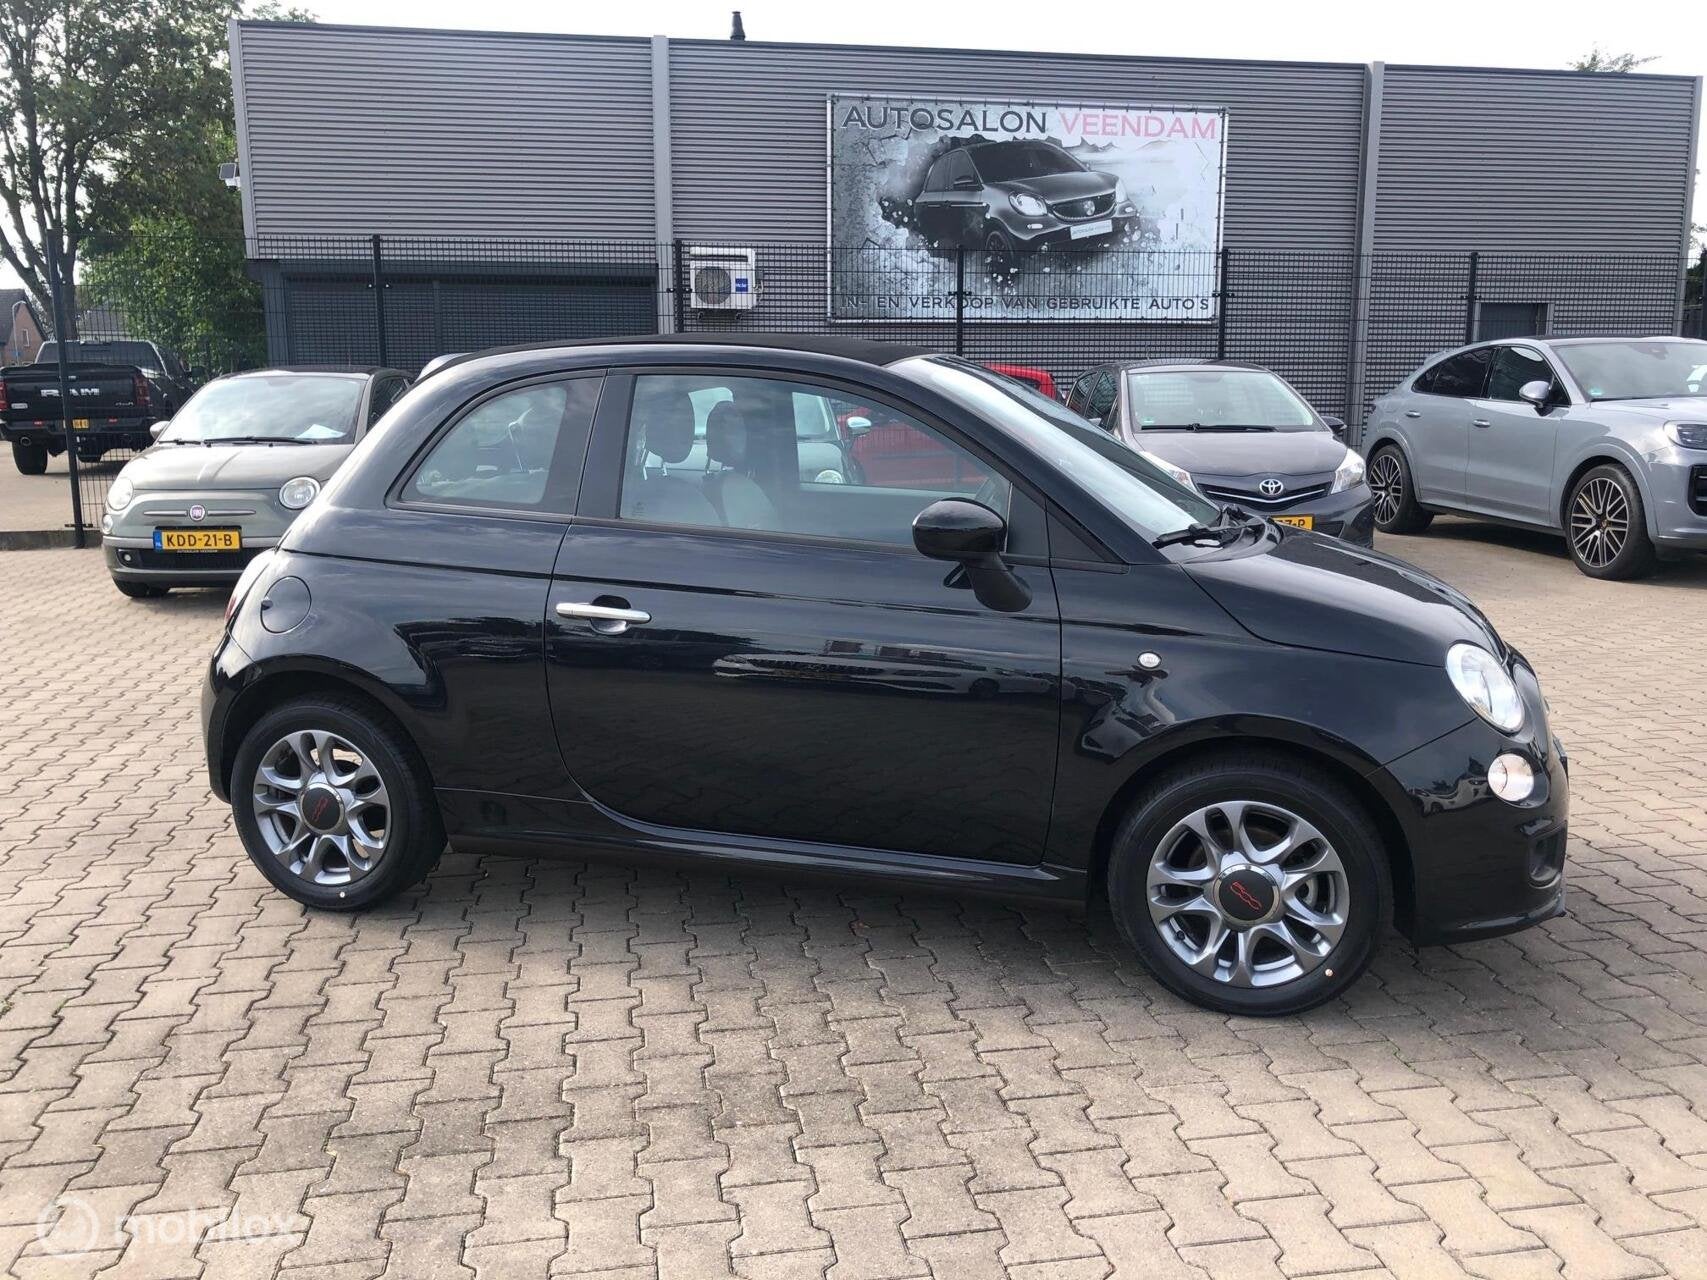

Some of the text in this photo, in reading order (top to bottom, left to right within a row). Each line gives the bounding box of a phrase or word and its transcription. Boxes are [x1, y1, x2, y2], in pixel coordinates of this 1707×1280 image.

[841, 105, 1217, 140] AUTOSALON VEENDAM
[877, 296, 899, 308] EN
[1001, 297, 1037, 309] VAN
[1046, 298, 1140, 310] GEBRUIKTE
[166, 533, 233, 547] KDD-21-B
